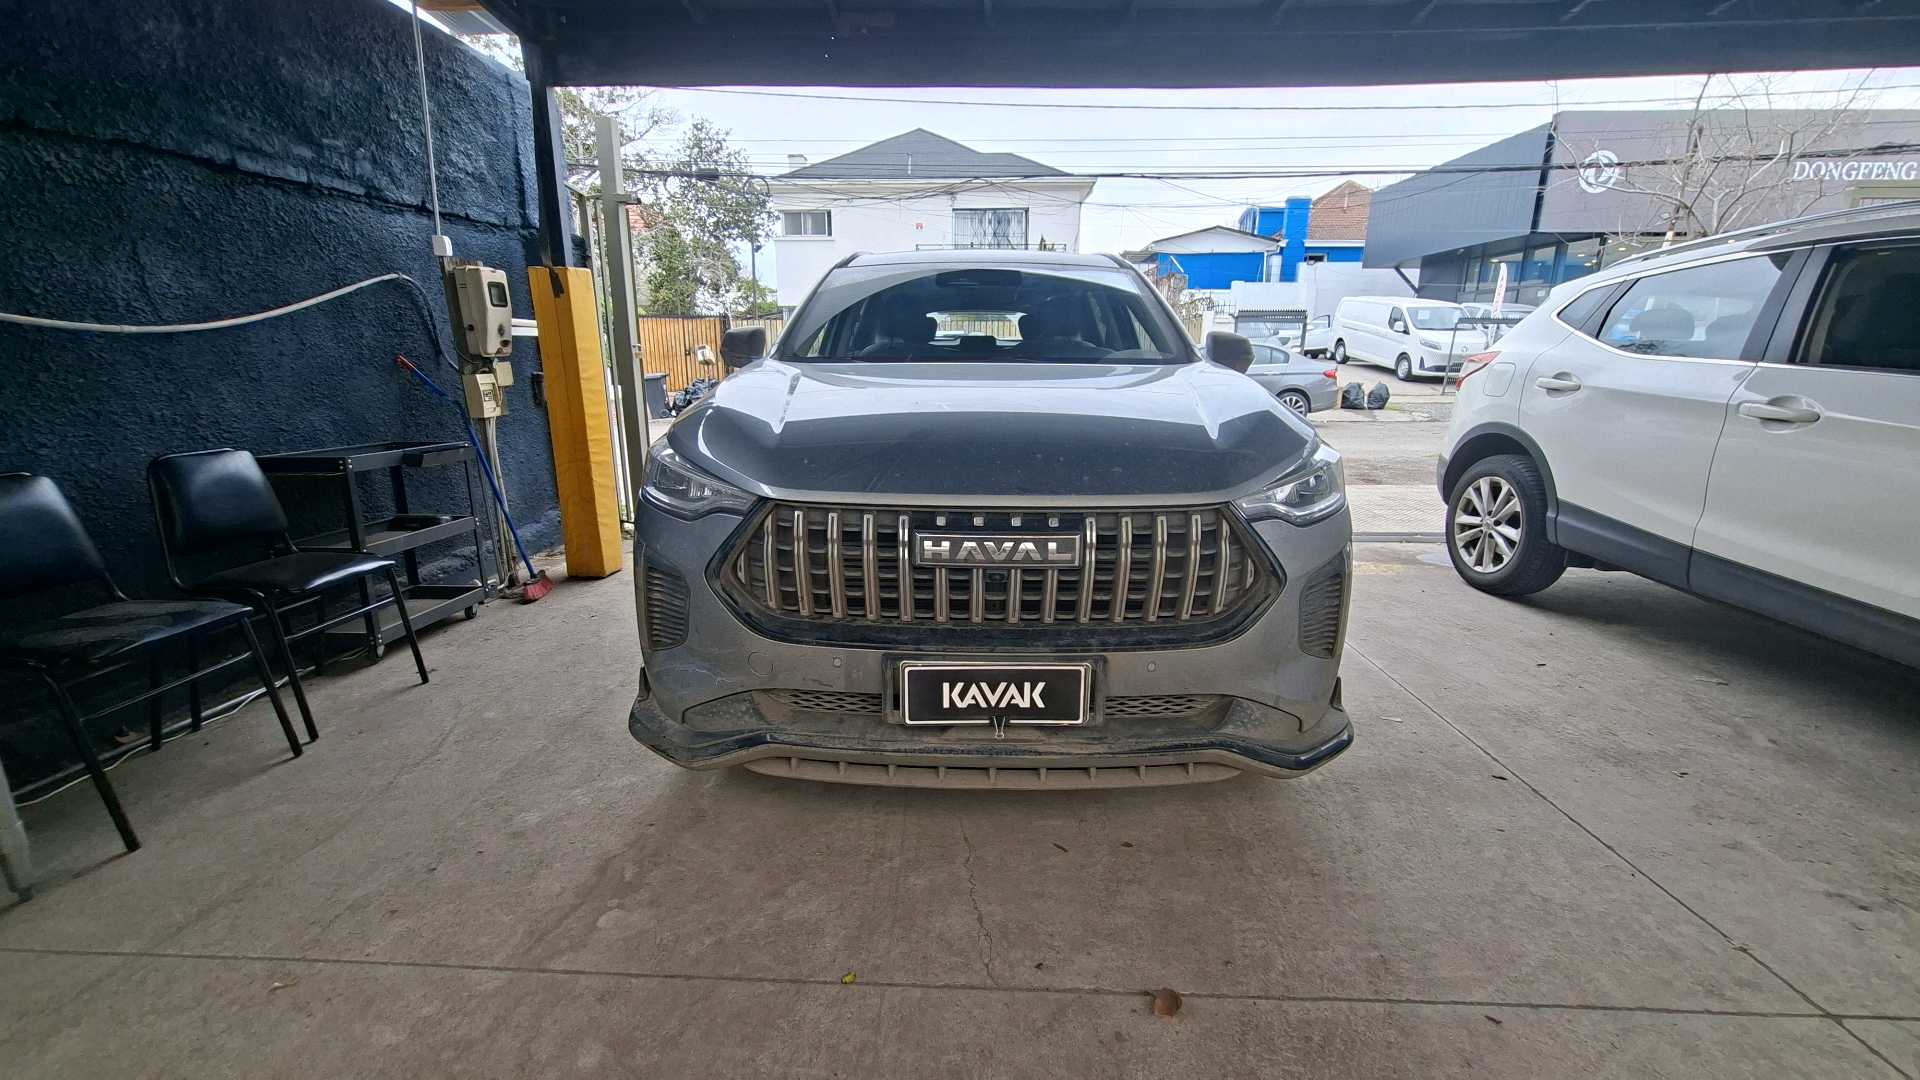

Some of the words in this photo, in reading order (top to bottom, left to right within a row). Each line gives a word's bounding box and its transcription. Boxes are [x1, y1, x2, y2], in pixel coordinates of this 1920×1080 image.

[1793, 161, 1918, 180] DONGFENG
[923, 540, 1072, 561] HAVAL
[942, 681, 1046, 708] KAVAK
